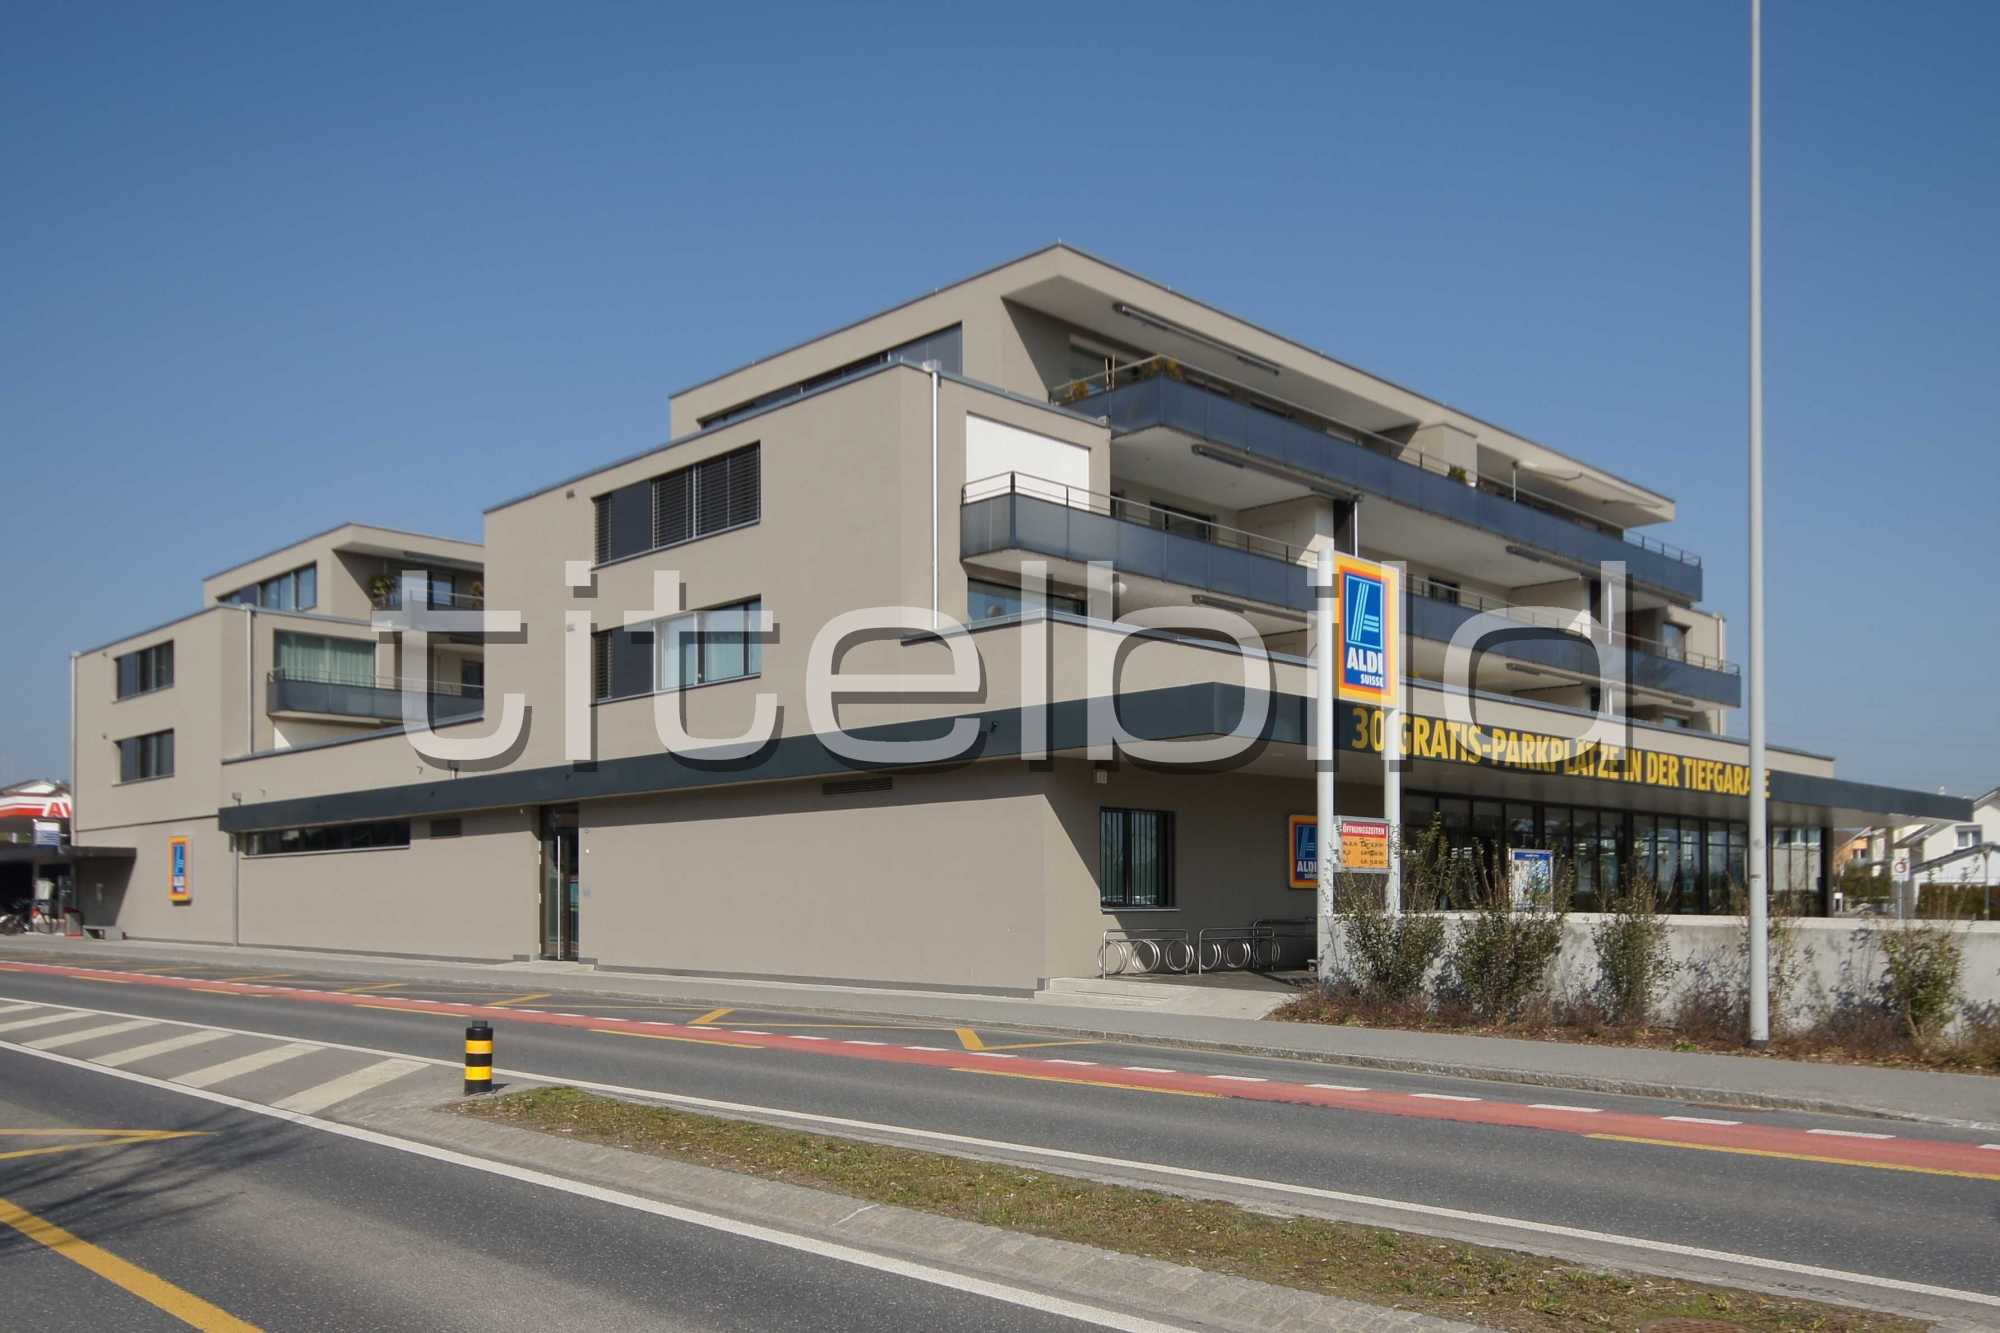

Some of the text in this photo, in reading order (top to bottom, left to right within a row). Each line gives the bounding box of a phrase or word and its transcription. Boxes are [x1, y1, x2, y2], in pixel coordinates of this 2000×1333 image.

[1346, 647, 1384, 675] ALDI
[1360, 674, 1384, 688] SUISSE
[1351, 707, 1385, 752] 30
[1624, 750, 1642, 783] IN
[1646, 753, 1680, 788] DER
[1683, 757, 1771, 798] TIEFGARAE
[1297, 861, 1317, 872] ALDI
